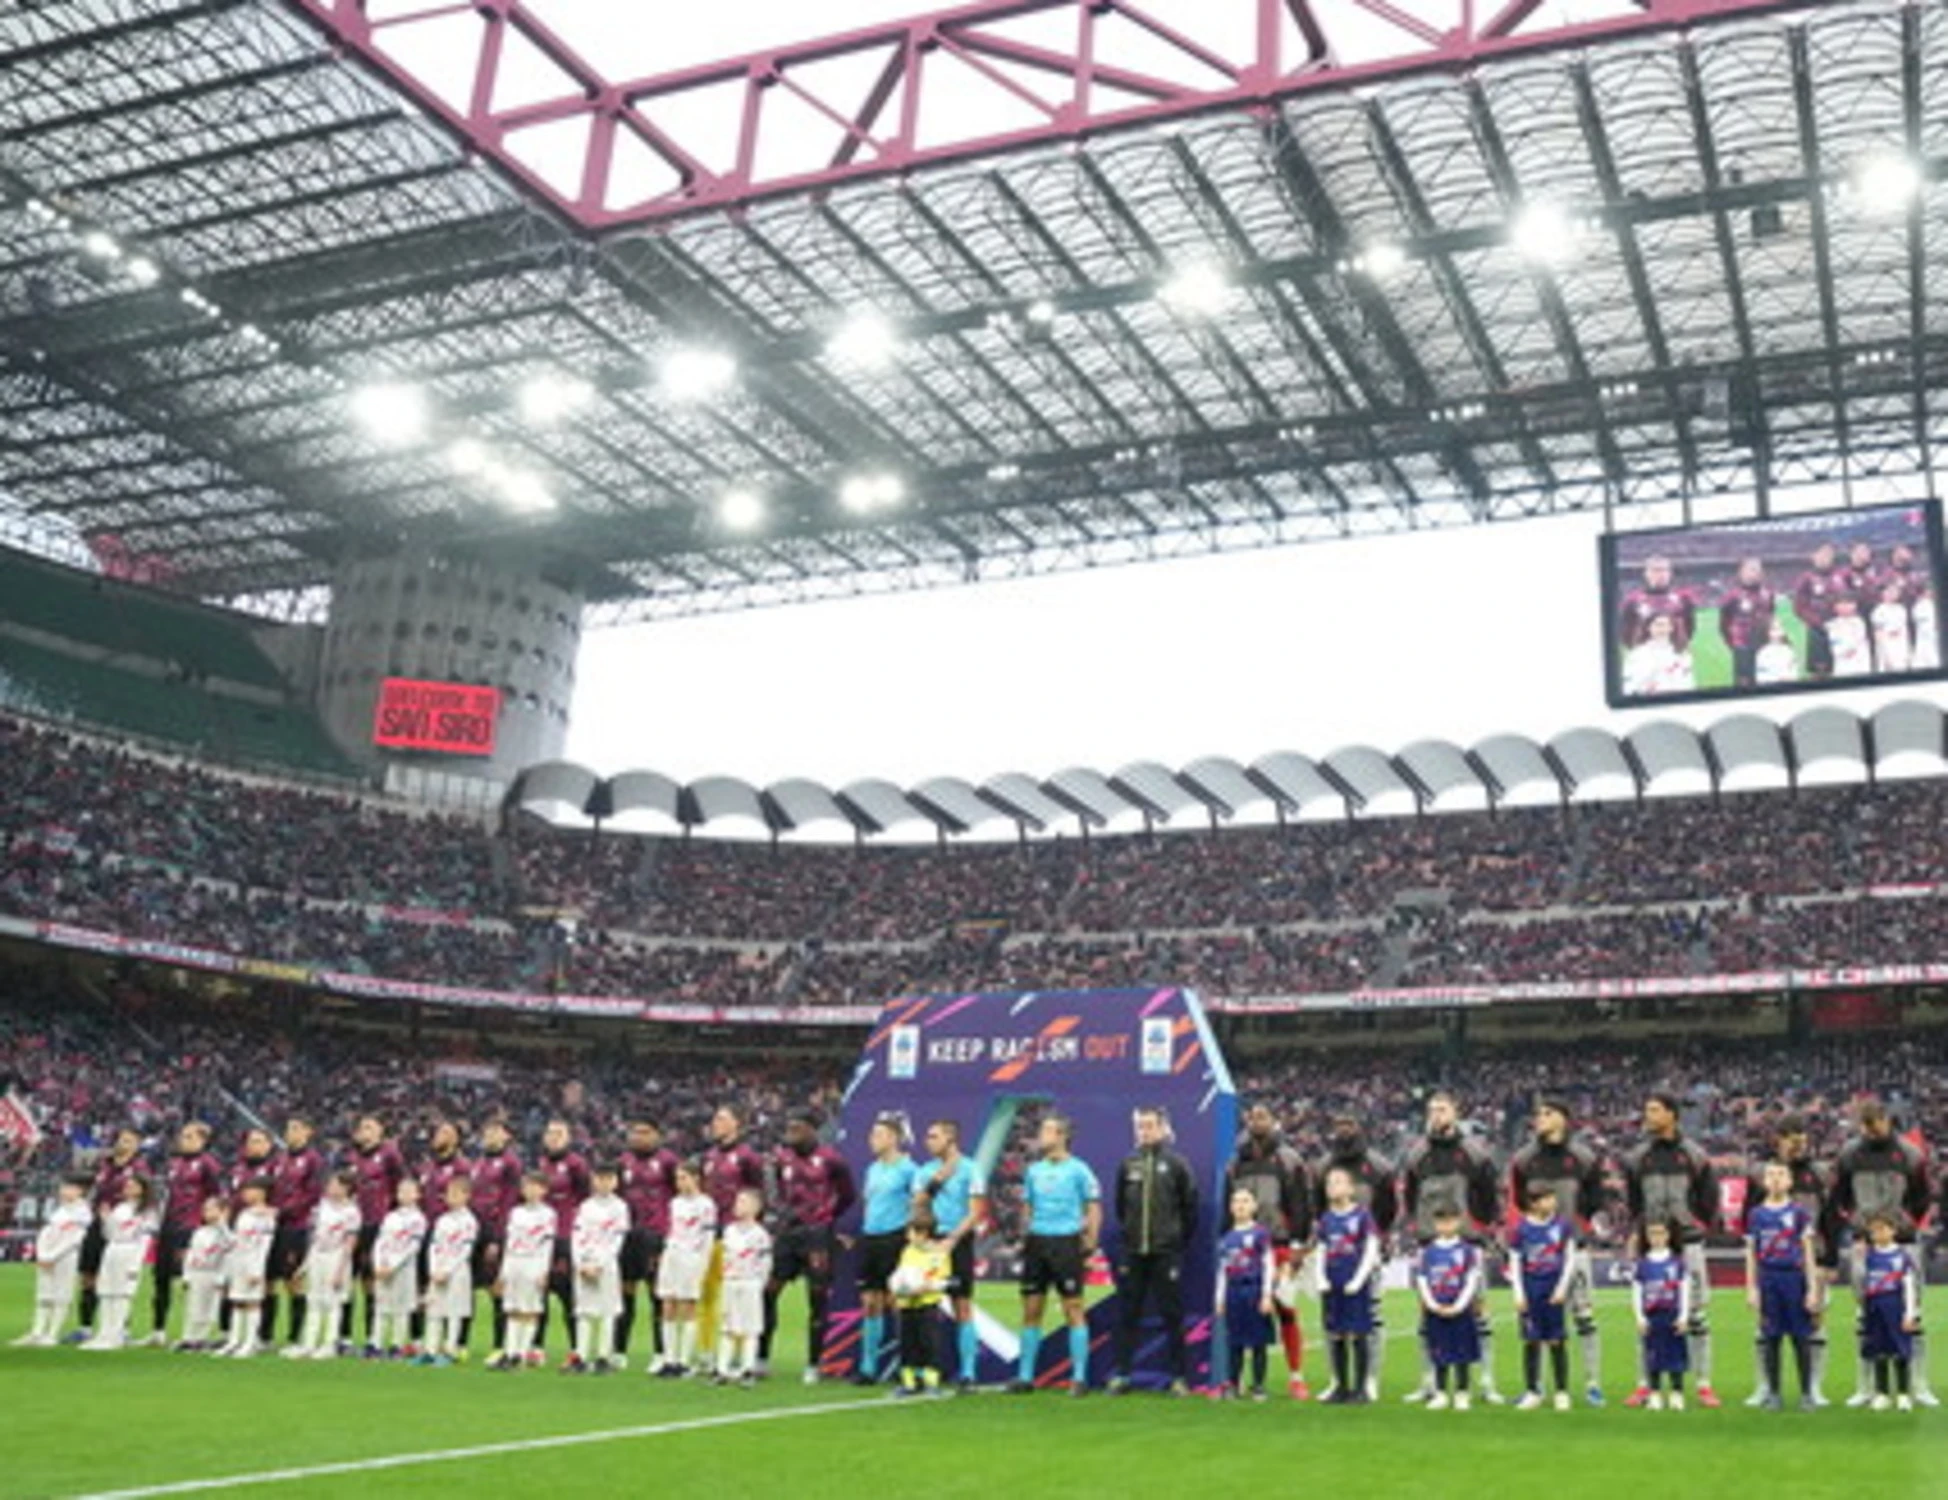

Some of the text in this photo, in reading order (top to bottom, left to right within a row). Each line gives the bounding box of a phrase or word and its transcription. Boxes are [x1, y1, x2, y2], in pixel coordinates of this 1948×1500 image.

[928, 1034, 1129, 1062] KEEP RACISM OUT
